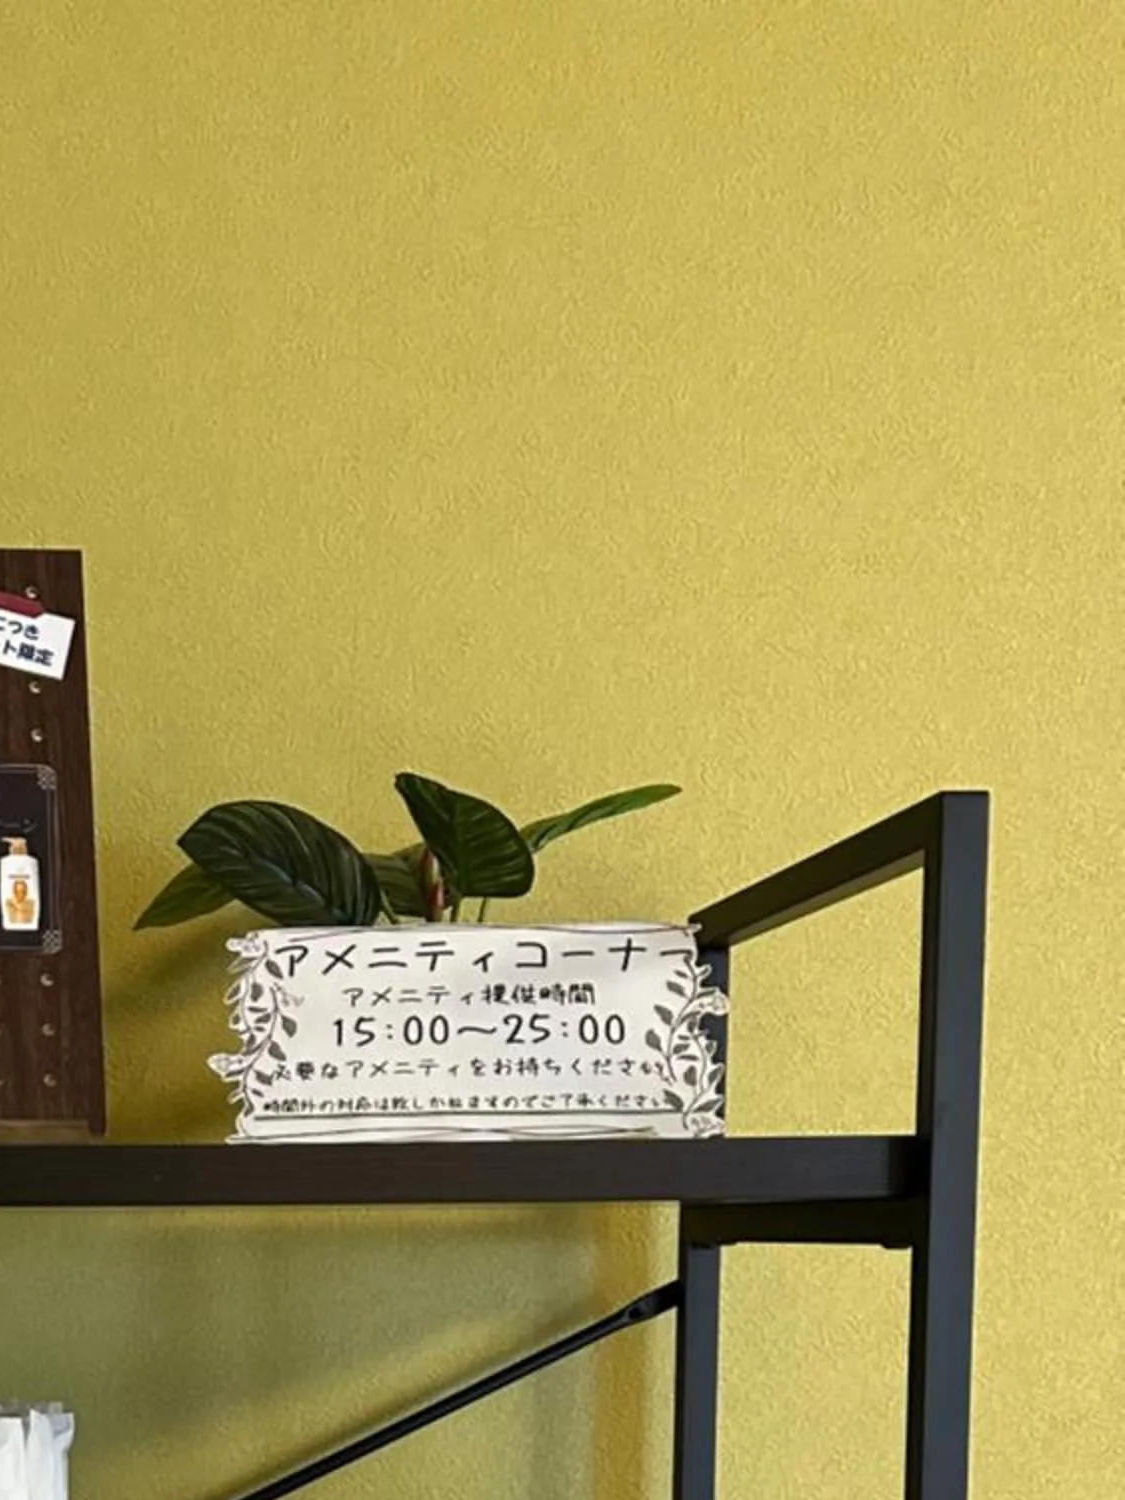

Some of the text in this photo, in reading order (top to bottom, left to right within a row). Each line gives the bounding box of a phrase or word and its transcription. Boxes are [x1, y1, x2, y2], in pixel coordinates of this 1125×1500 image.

[275, 937, 695, 978] アメニティコーナー
[342, 983, 597, 1006] アメニティ提供時間
